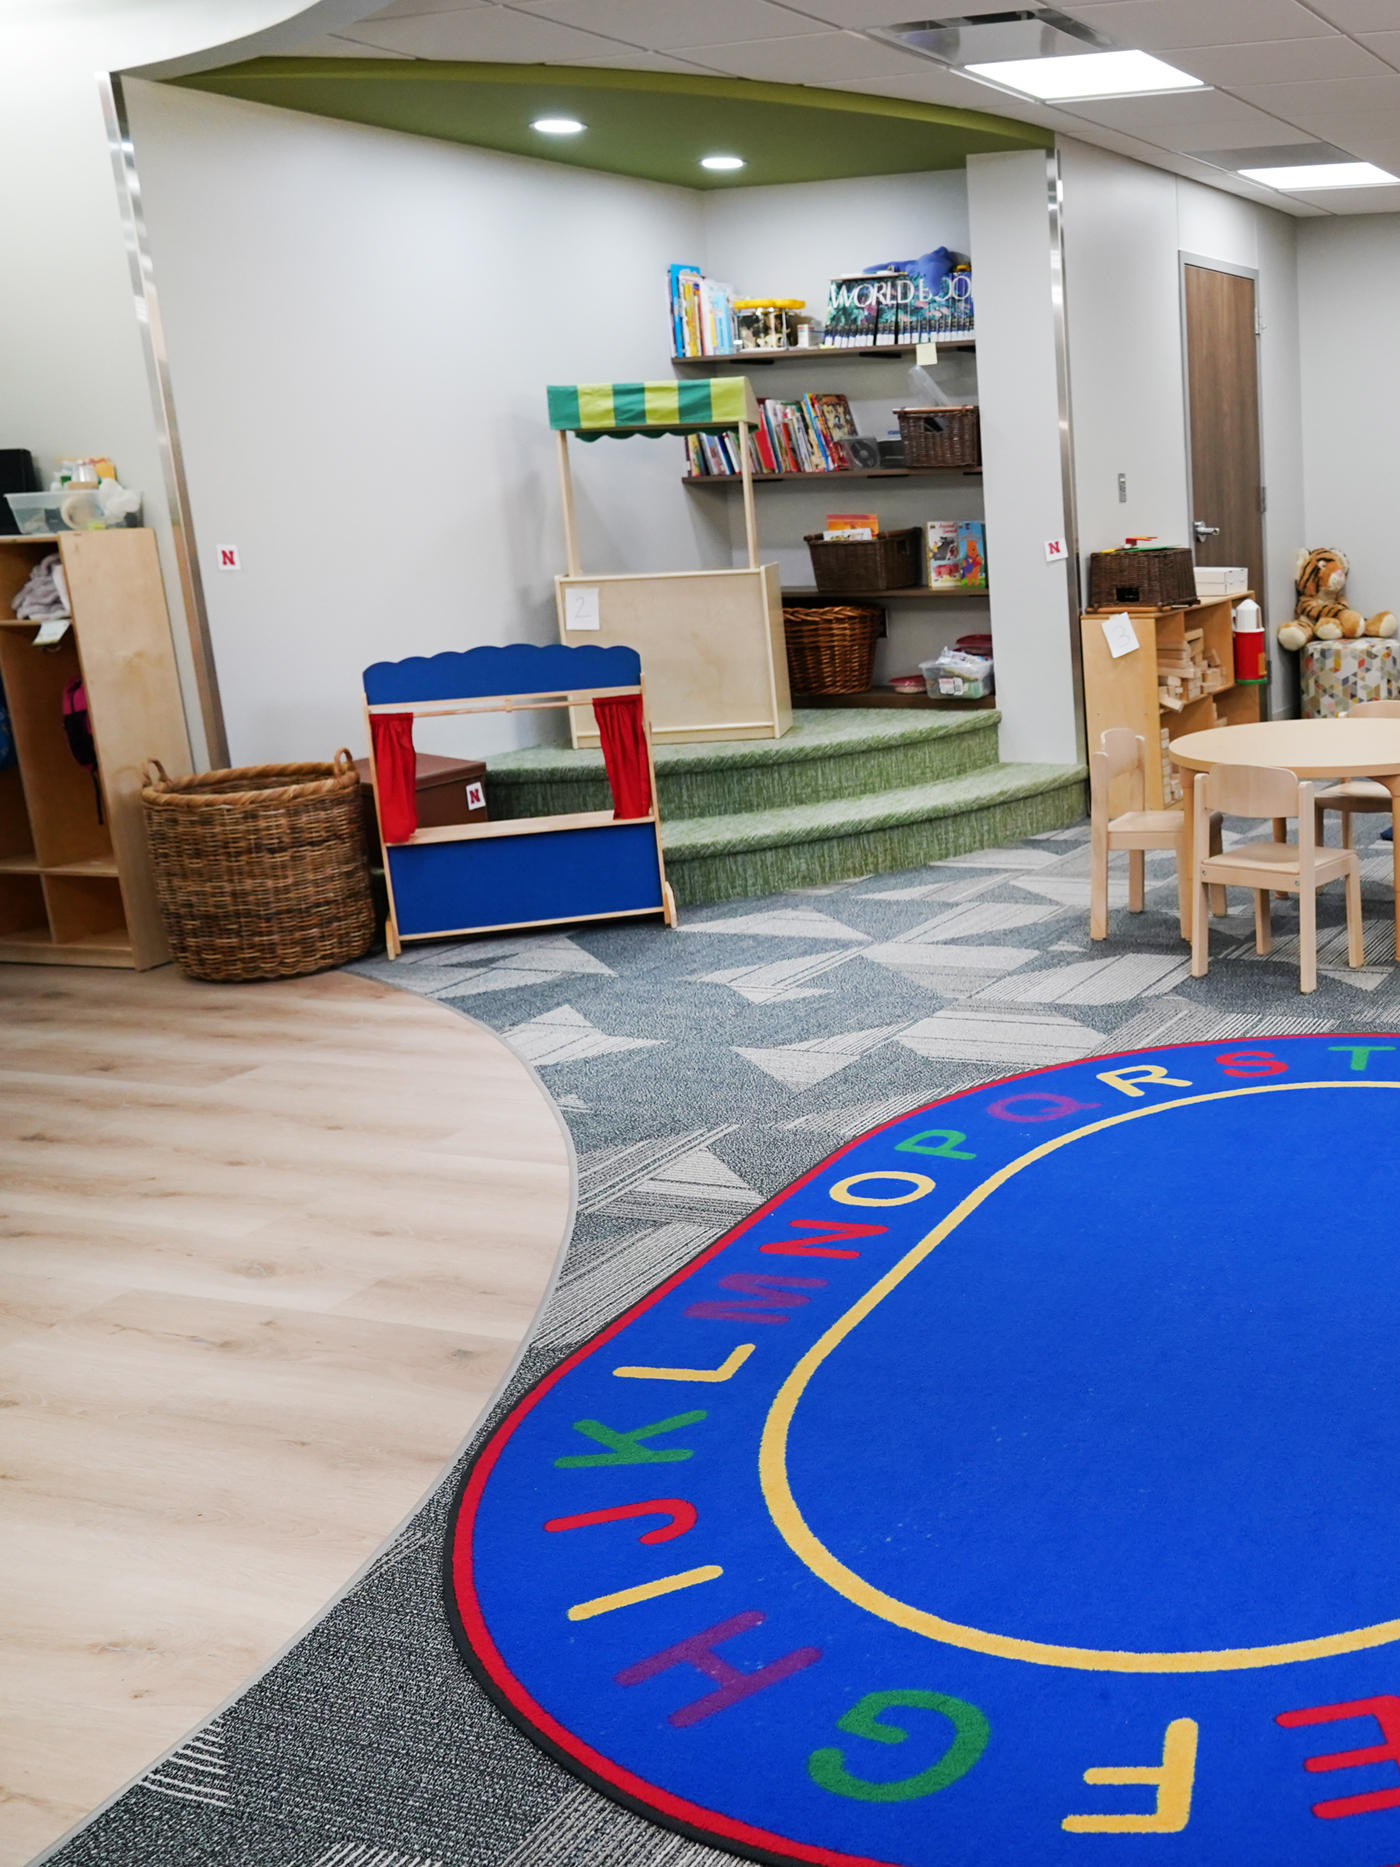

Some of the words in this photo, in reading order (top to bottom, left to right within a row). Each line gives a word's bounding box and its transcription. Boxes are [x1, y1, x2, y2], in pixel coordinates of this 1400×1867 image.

[831, 280, 914, 308] WORLD
[221, 550, 236, 566] N
[1048, 541, 1061, 555] N
[575, 596, 592, 619] 2
[1113, 625, 1131, 648] 3
[469, 788, 481, 804] N
[1215, 1051, 1288, 1077] S
[1329, 1046, 1395, 1070] T
[1096, 1065, 1192, 1097] R
[987, 1093, 1101, 1122] Q
[895, 1129, 976, 1160] P
[829, 1171, 936, 1207] O
[759, 1219, 888, 1259] N
[683, 1273, 828, 1324] M
[613, 1344, 755, 1382] L
[554, 1410, 707, 1468] K
[544, 1498, 697, 1545] J
[568, 1565, 723, 1621] I
[614, 1610, 822, 1728] H
[807, 1689, 991, 1802] G
[1061, 1718, 1198, 1833] F
